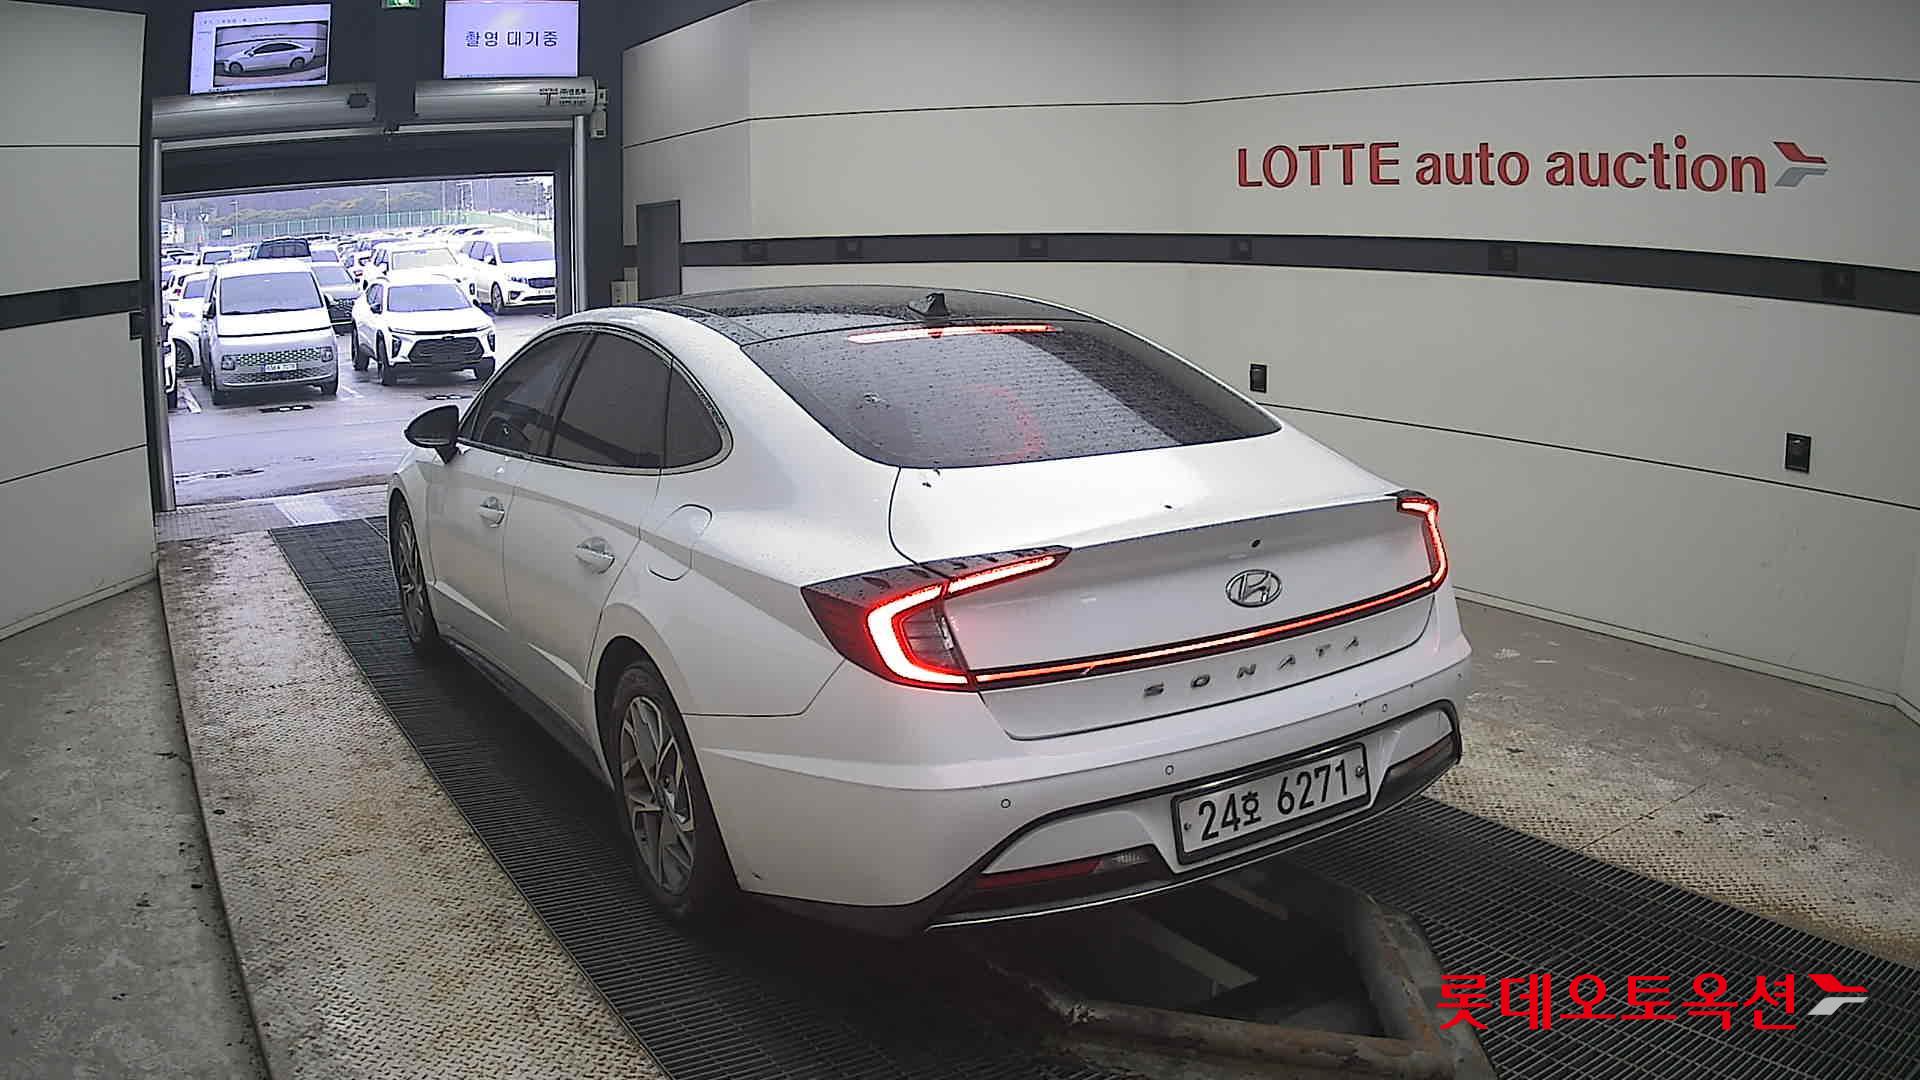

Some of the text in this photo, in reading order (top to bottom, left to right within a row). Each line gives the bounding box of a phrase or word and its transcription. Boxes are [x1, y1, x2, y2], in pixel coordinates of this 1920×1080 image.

[506, 30, 558, 48] 대기중
[1238, 134, 1767, 193] LOTTE auto auction
[1142, 636, 1361, 699] SONATA
[1198, 759, 1348, 840] 24호 6271
